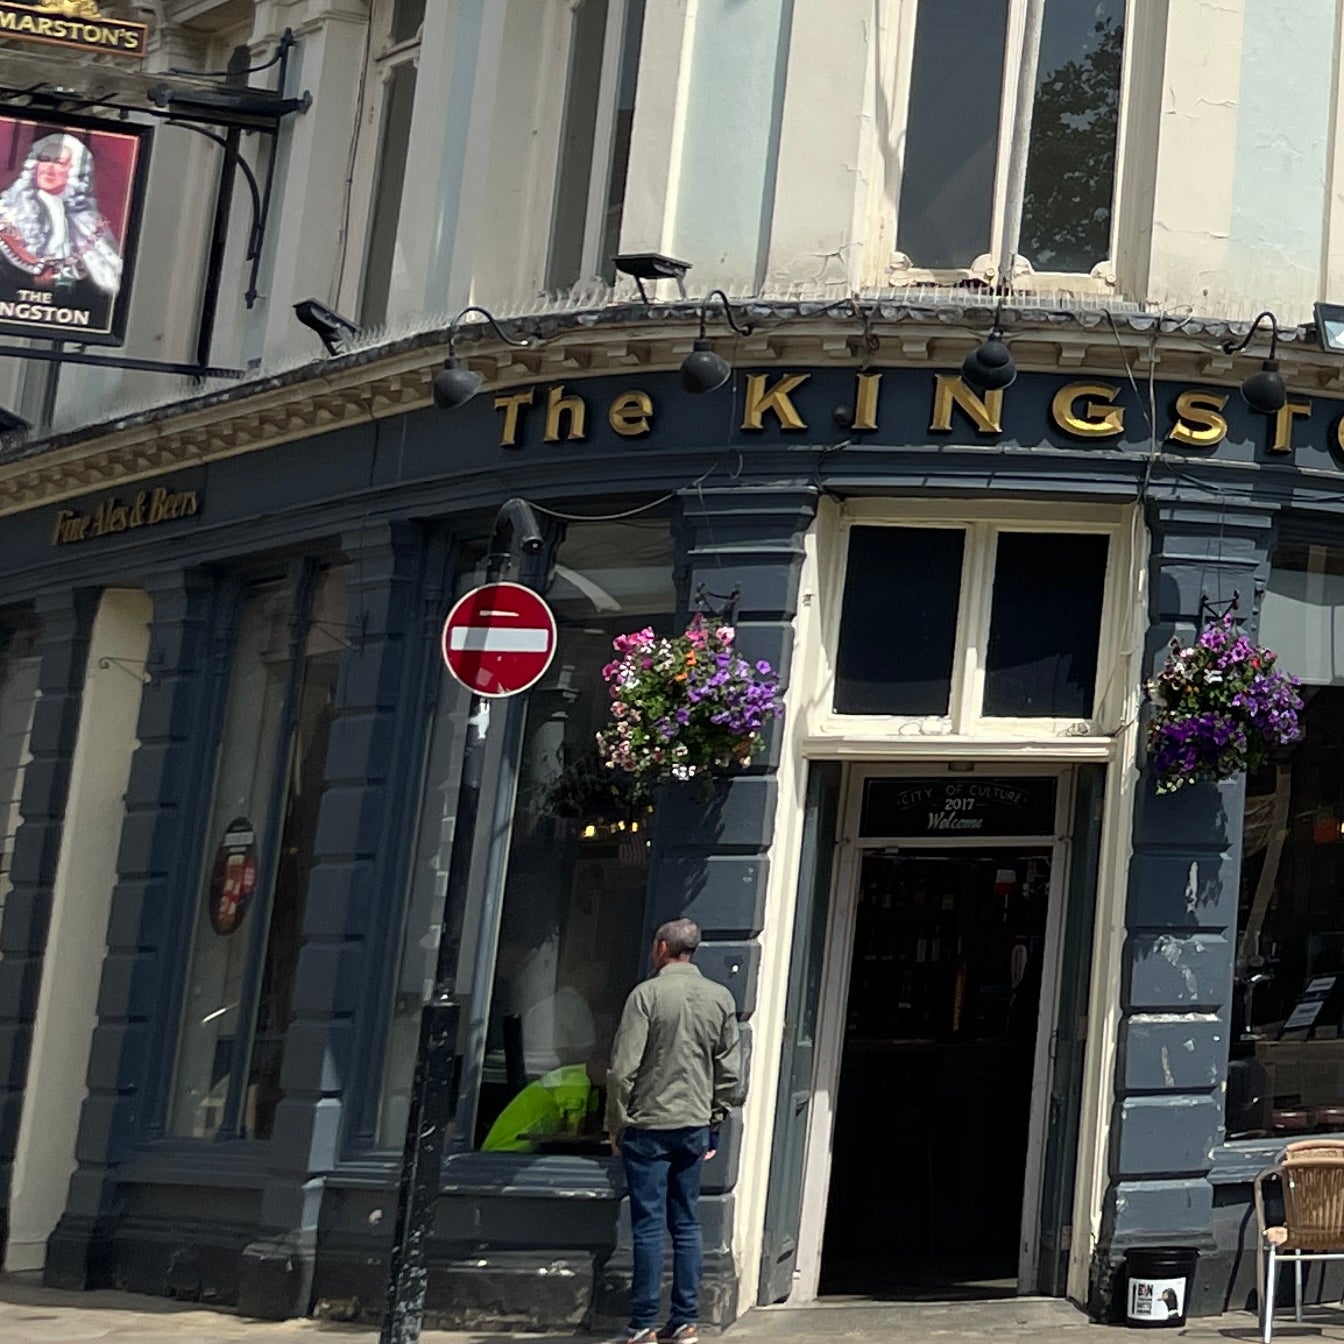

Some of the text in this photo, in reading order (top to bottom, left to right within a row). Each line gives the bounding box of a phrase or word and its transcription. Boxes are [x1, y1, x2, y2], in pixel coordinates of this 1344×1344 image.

[0, 10, 139, 48] MARSTON'S
[17, 289, 52, 303] THE
[494, 385, 653, 446] The
[94, 497, 129, 535] Ales
[150, 487, 197, 524] Beers
[901, 784, 1023, 805] CITY OF CULTURE
[944, 798, 976, 811] 2017
[926, 811, 984, 830] Welcome
